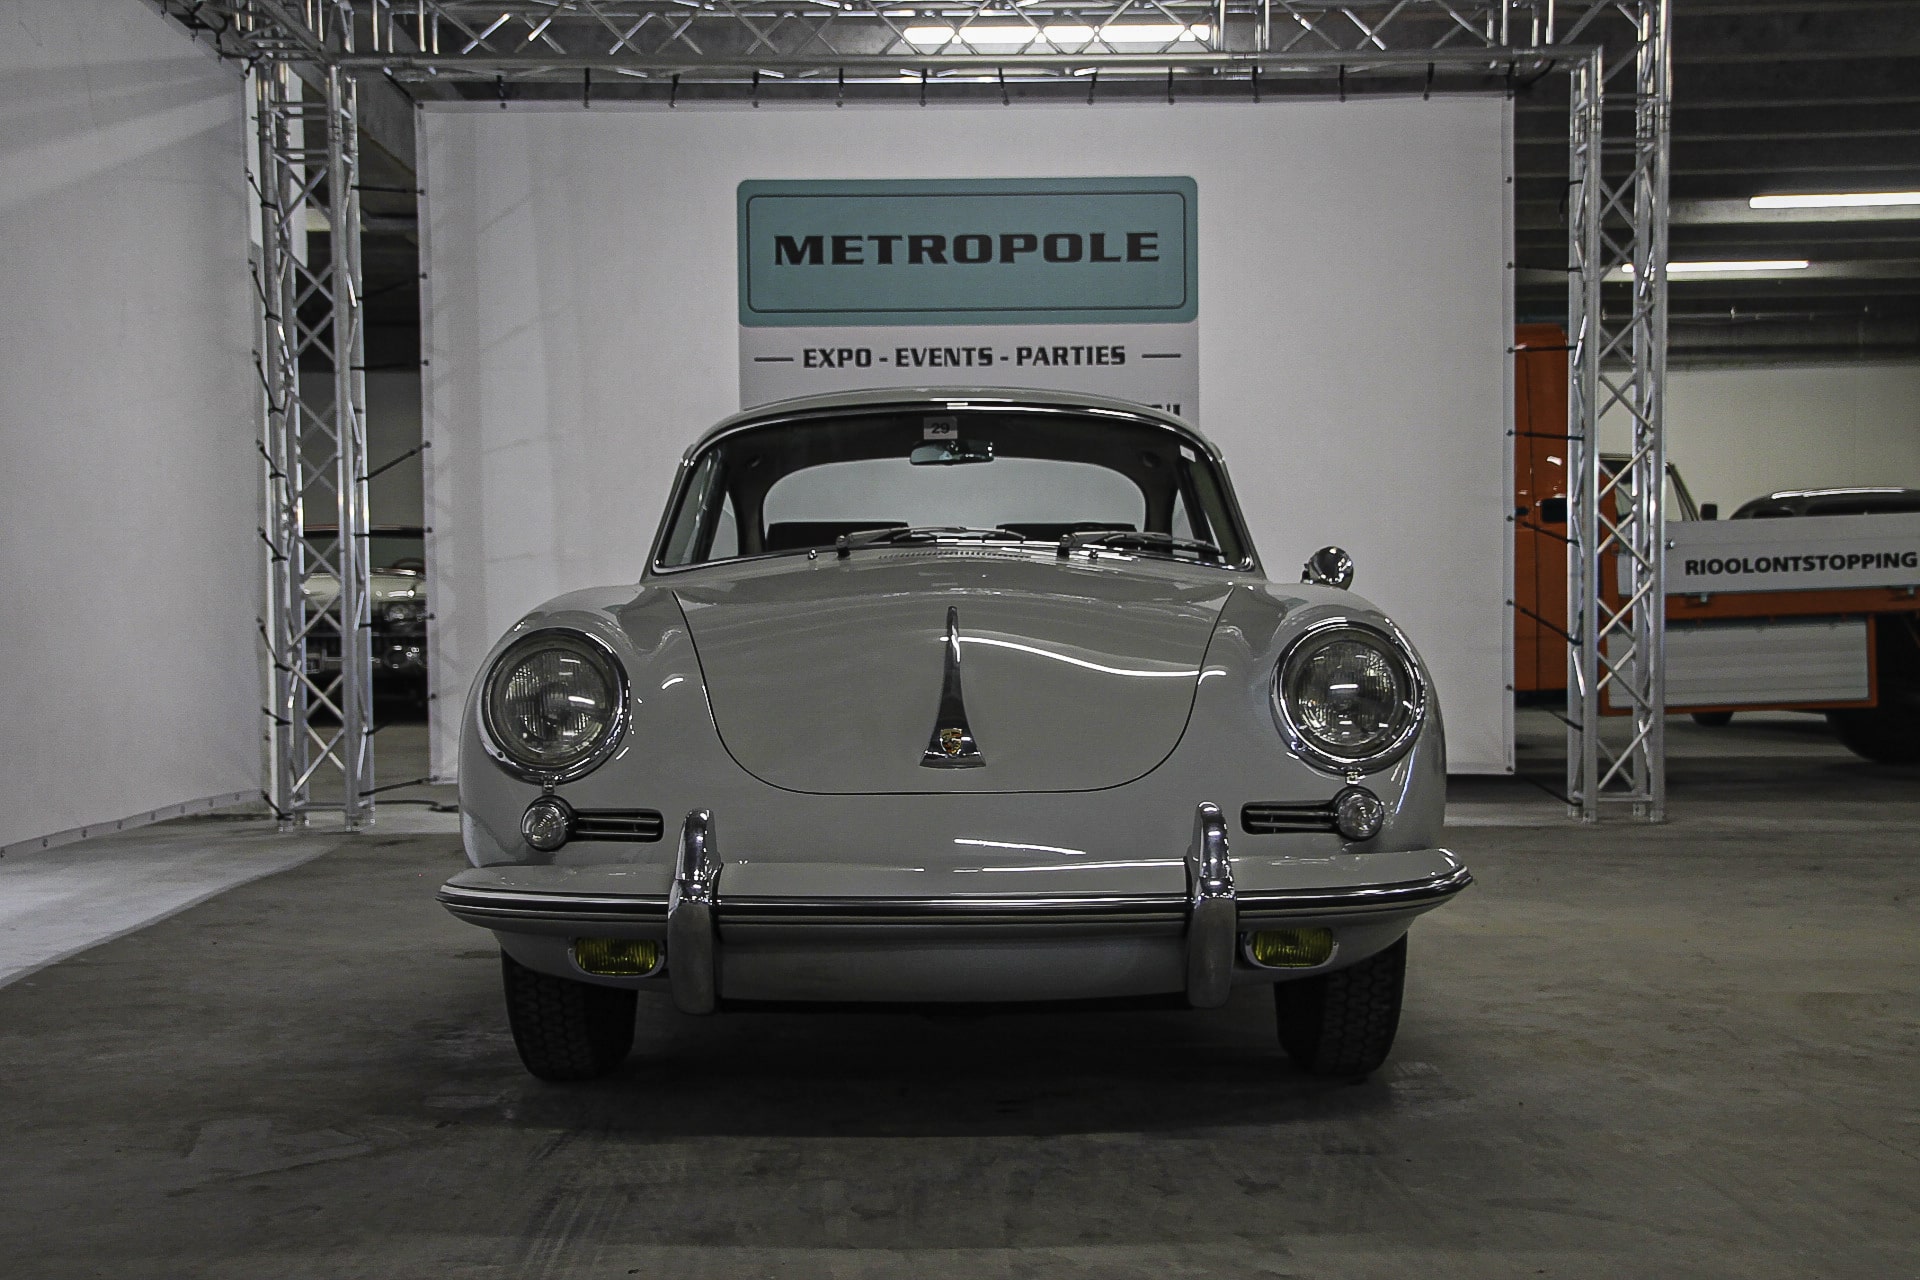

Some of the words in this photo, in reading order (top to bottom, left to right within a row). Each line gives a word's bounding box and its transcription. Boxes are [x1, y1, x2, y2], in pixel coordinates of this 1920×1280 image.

[774, 233, 1160, 266] METROPOLE
[803, 347, 872, 369] EXPO
[895, 346, 993, 368] EVENTS
[1016, 345, 1126, 367] PARTIES
[930, 422, 951, 435] 29
[1684, 551, 1918, 576] RIOOLONTSTOPPING
